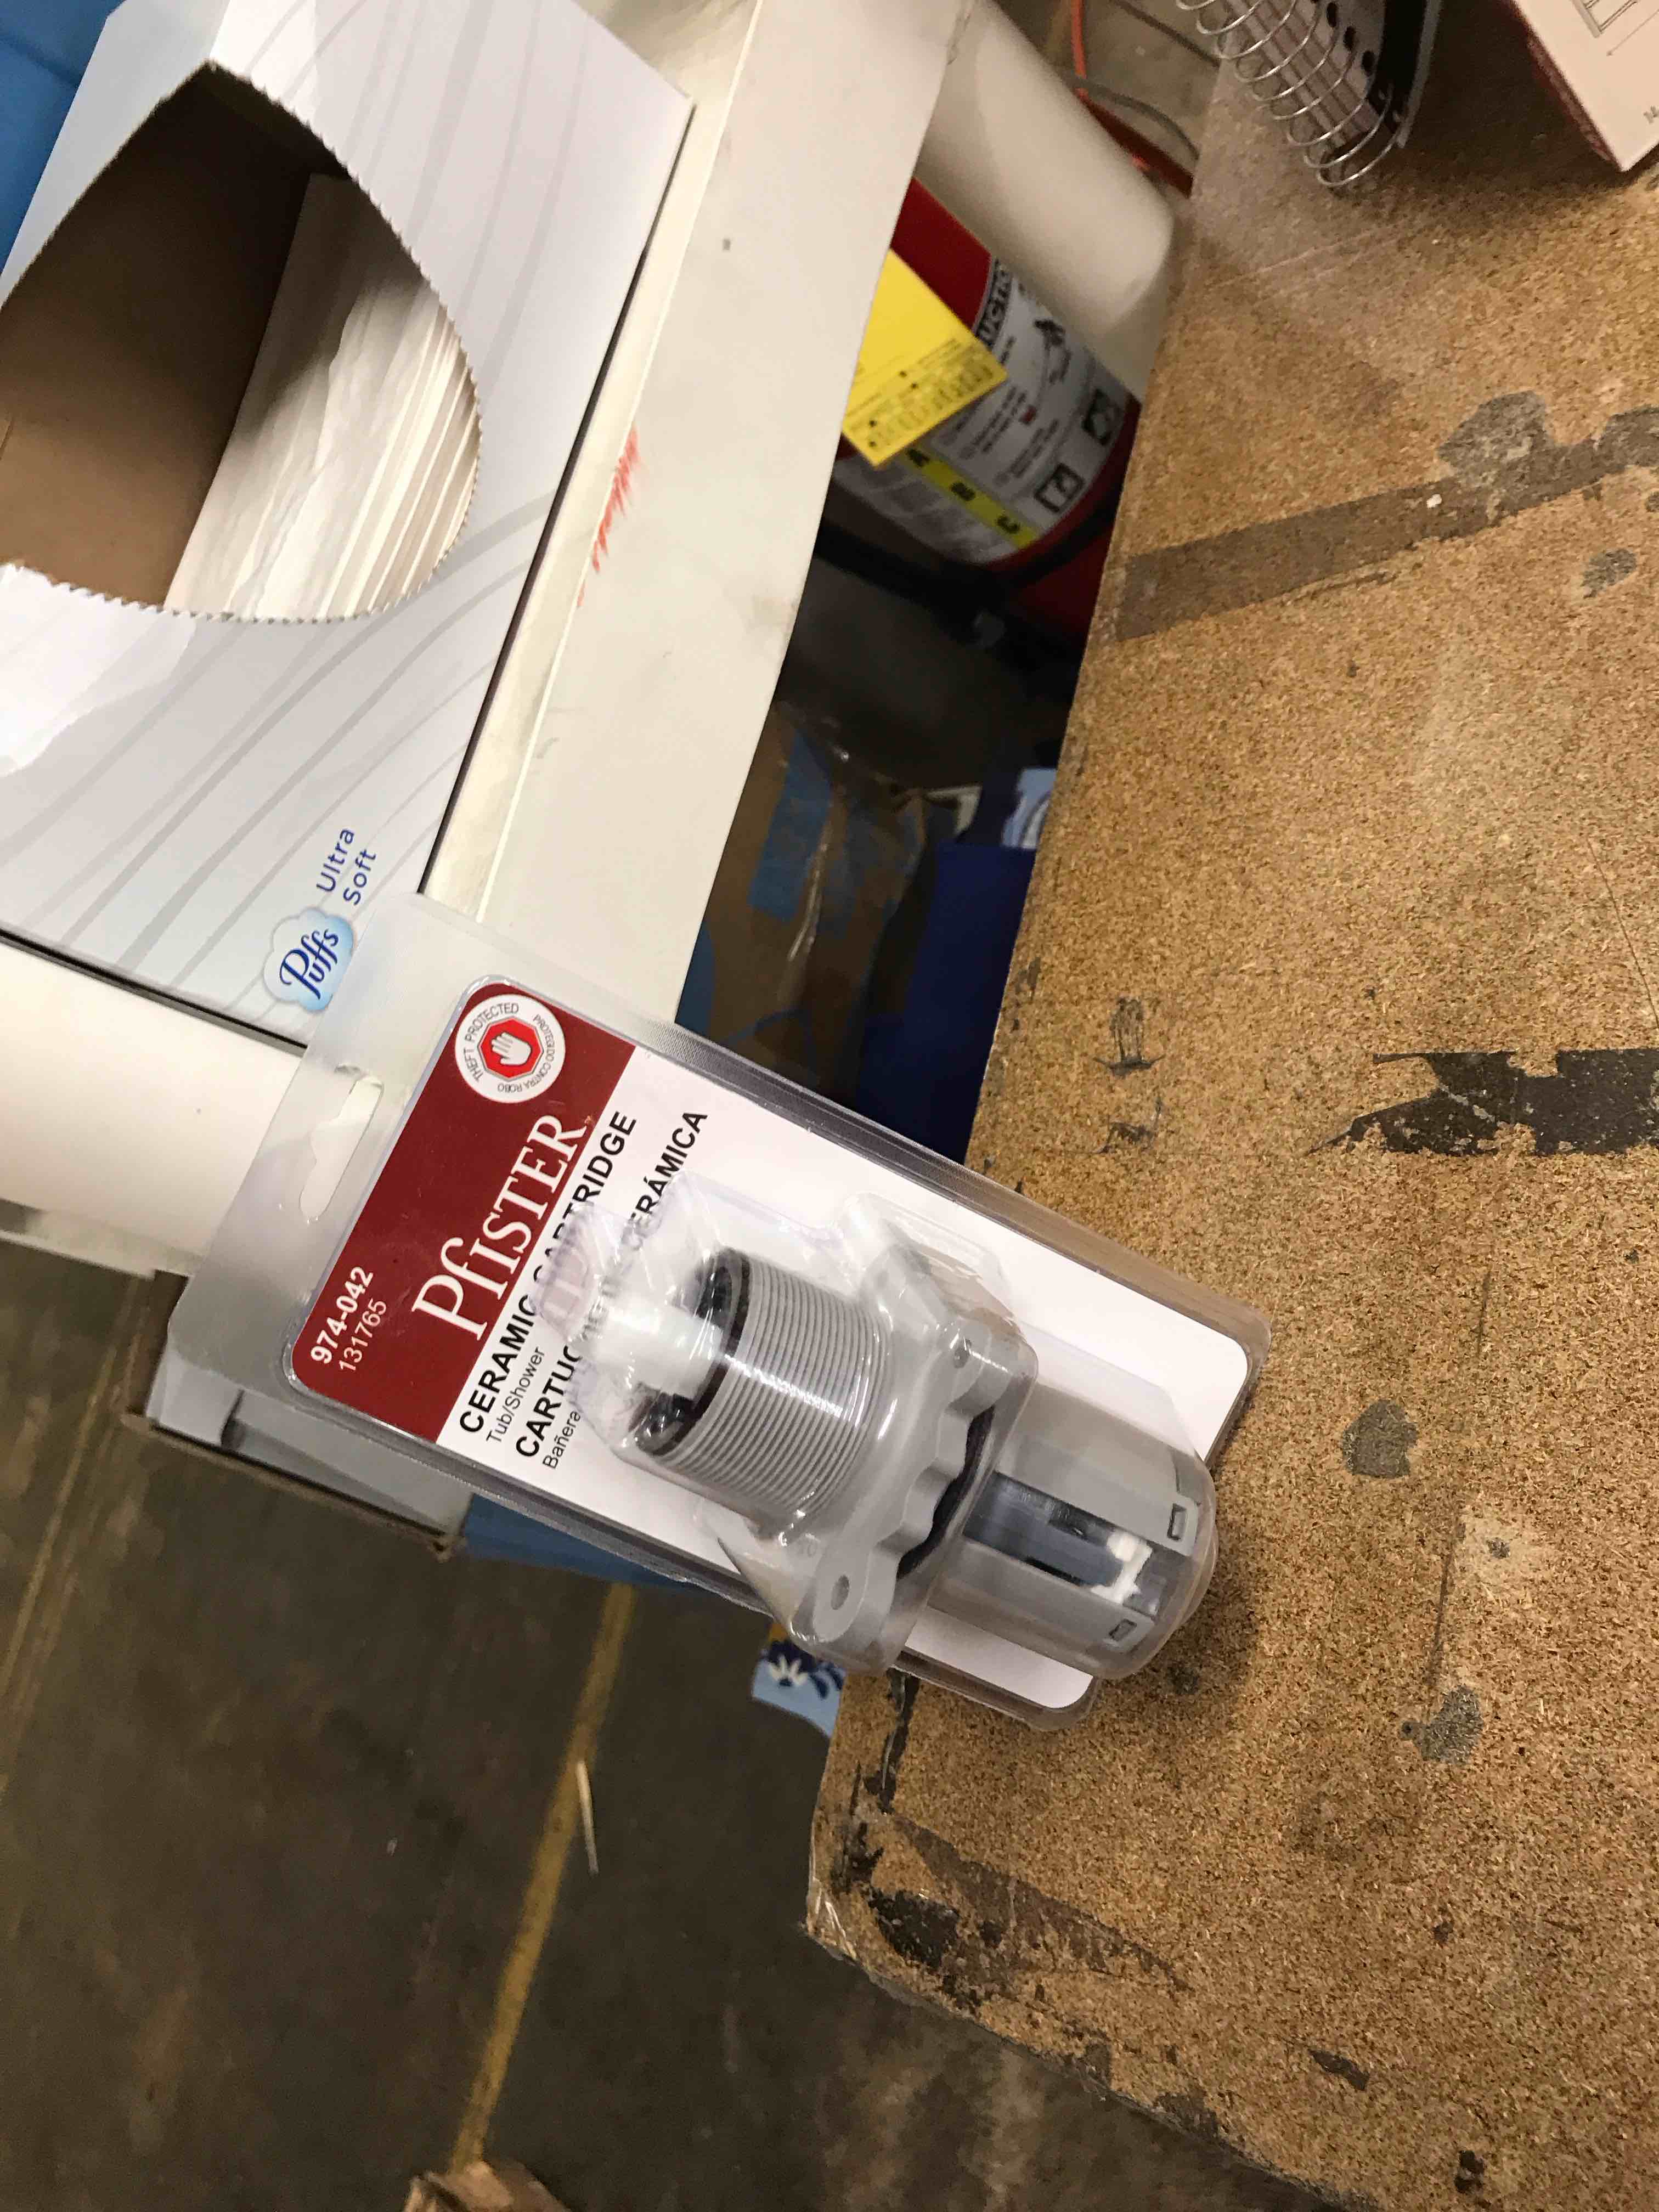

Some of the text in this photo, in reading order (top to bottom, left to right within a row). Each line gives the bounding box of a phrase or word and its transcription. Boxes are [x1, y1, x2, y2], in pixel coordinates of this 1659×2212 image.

[315, 827, 355, 893] Ultra
[343, 848, 377, 906] Soft
[279, 928, 339, 1000] Puffs
[463, 1002, 519, 1082] THEFT PROTECTED
[497, 1014, 556, 1093] PROTEGIDO CONTRA ROBO
[459, 1111, 637, 1433] CERAMIC RIDGE
[310, 1266, 374, 1364] 974-042
[338, 1297, 387, 1371] 131765
[486, 1346, 545, 1442] Tub/Shower
[516, 1319, 595, 1457] CARTUC
